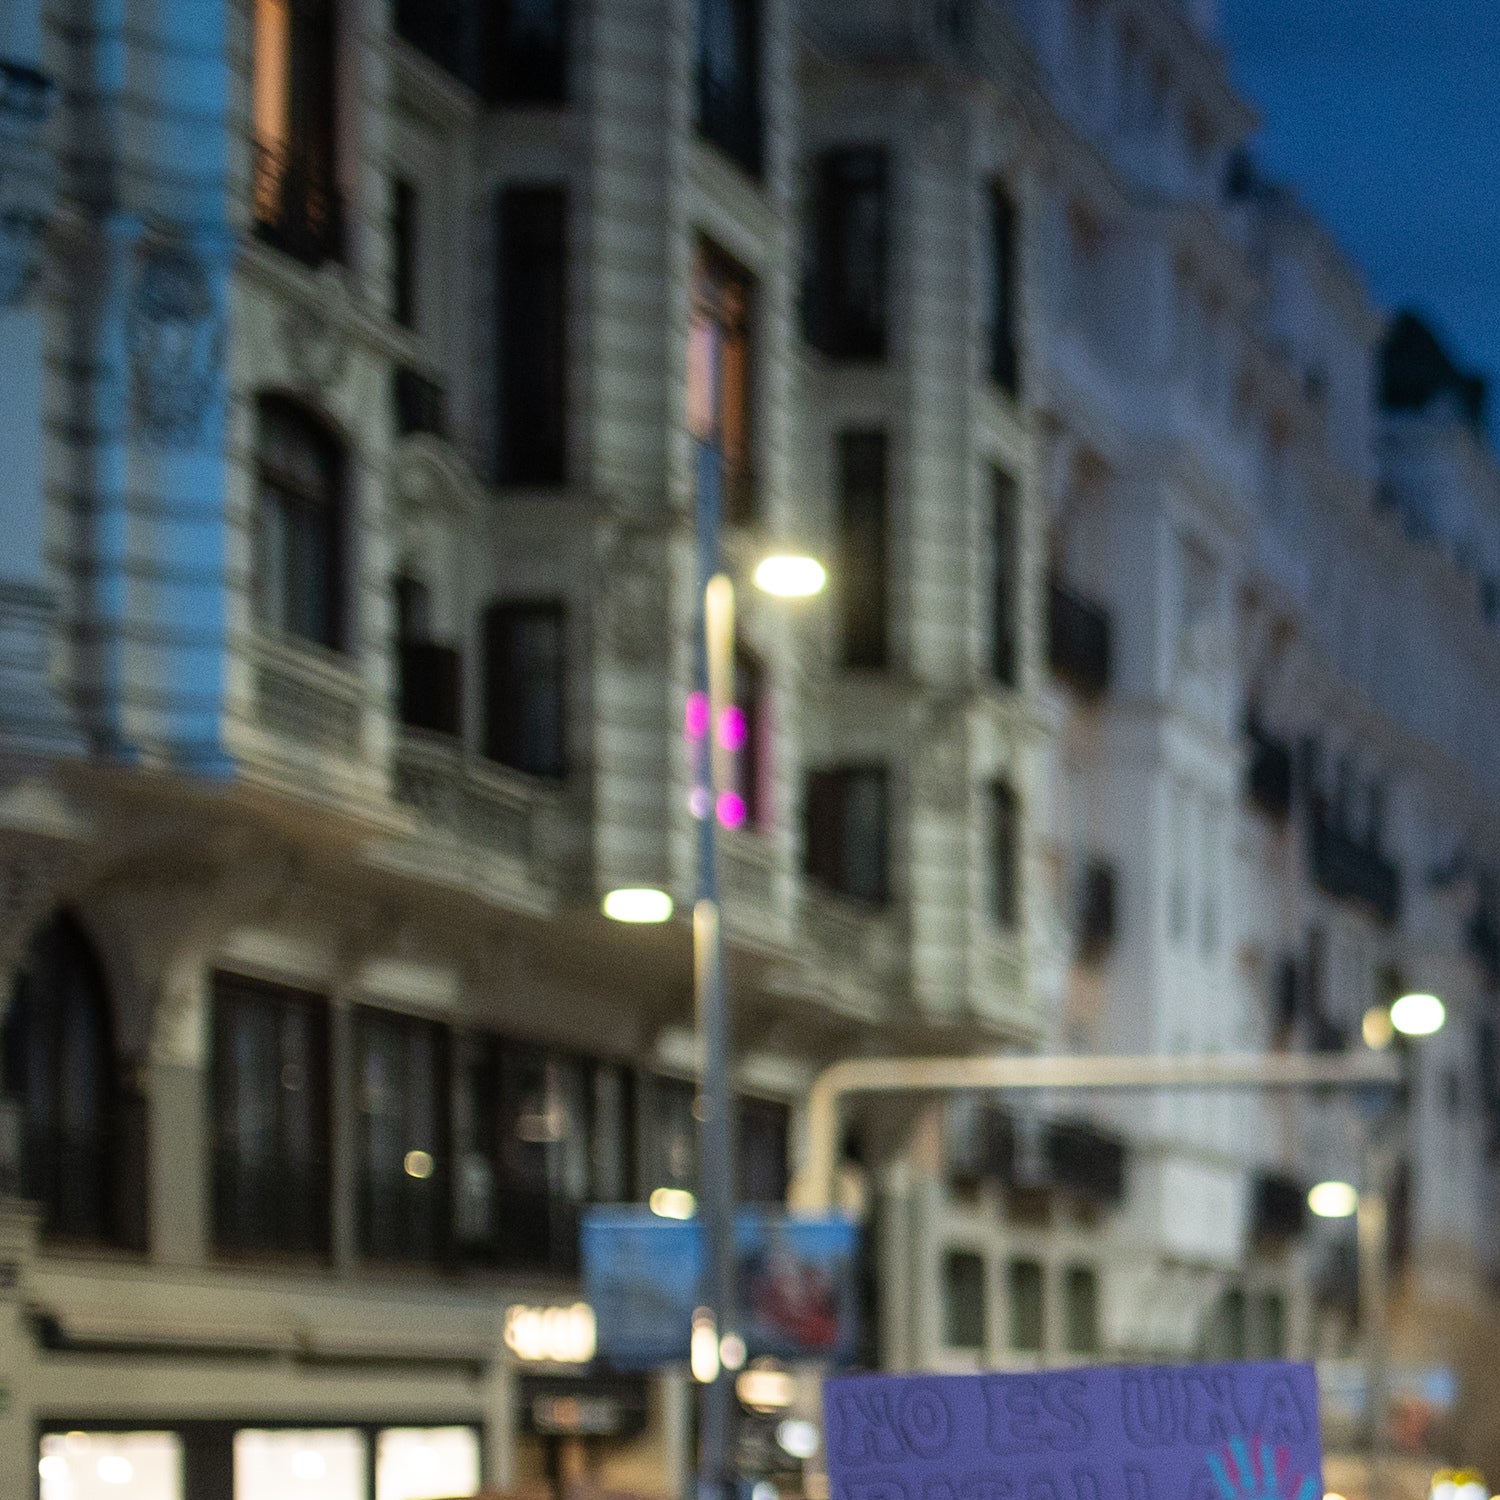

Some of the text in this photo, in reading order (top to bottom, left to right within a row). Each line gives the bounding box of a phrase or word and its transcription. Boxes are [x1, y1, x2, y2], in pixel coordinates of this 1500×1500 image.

[837, 1366, 1314, 1467] NO ES UNA
